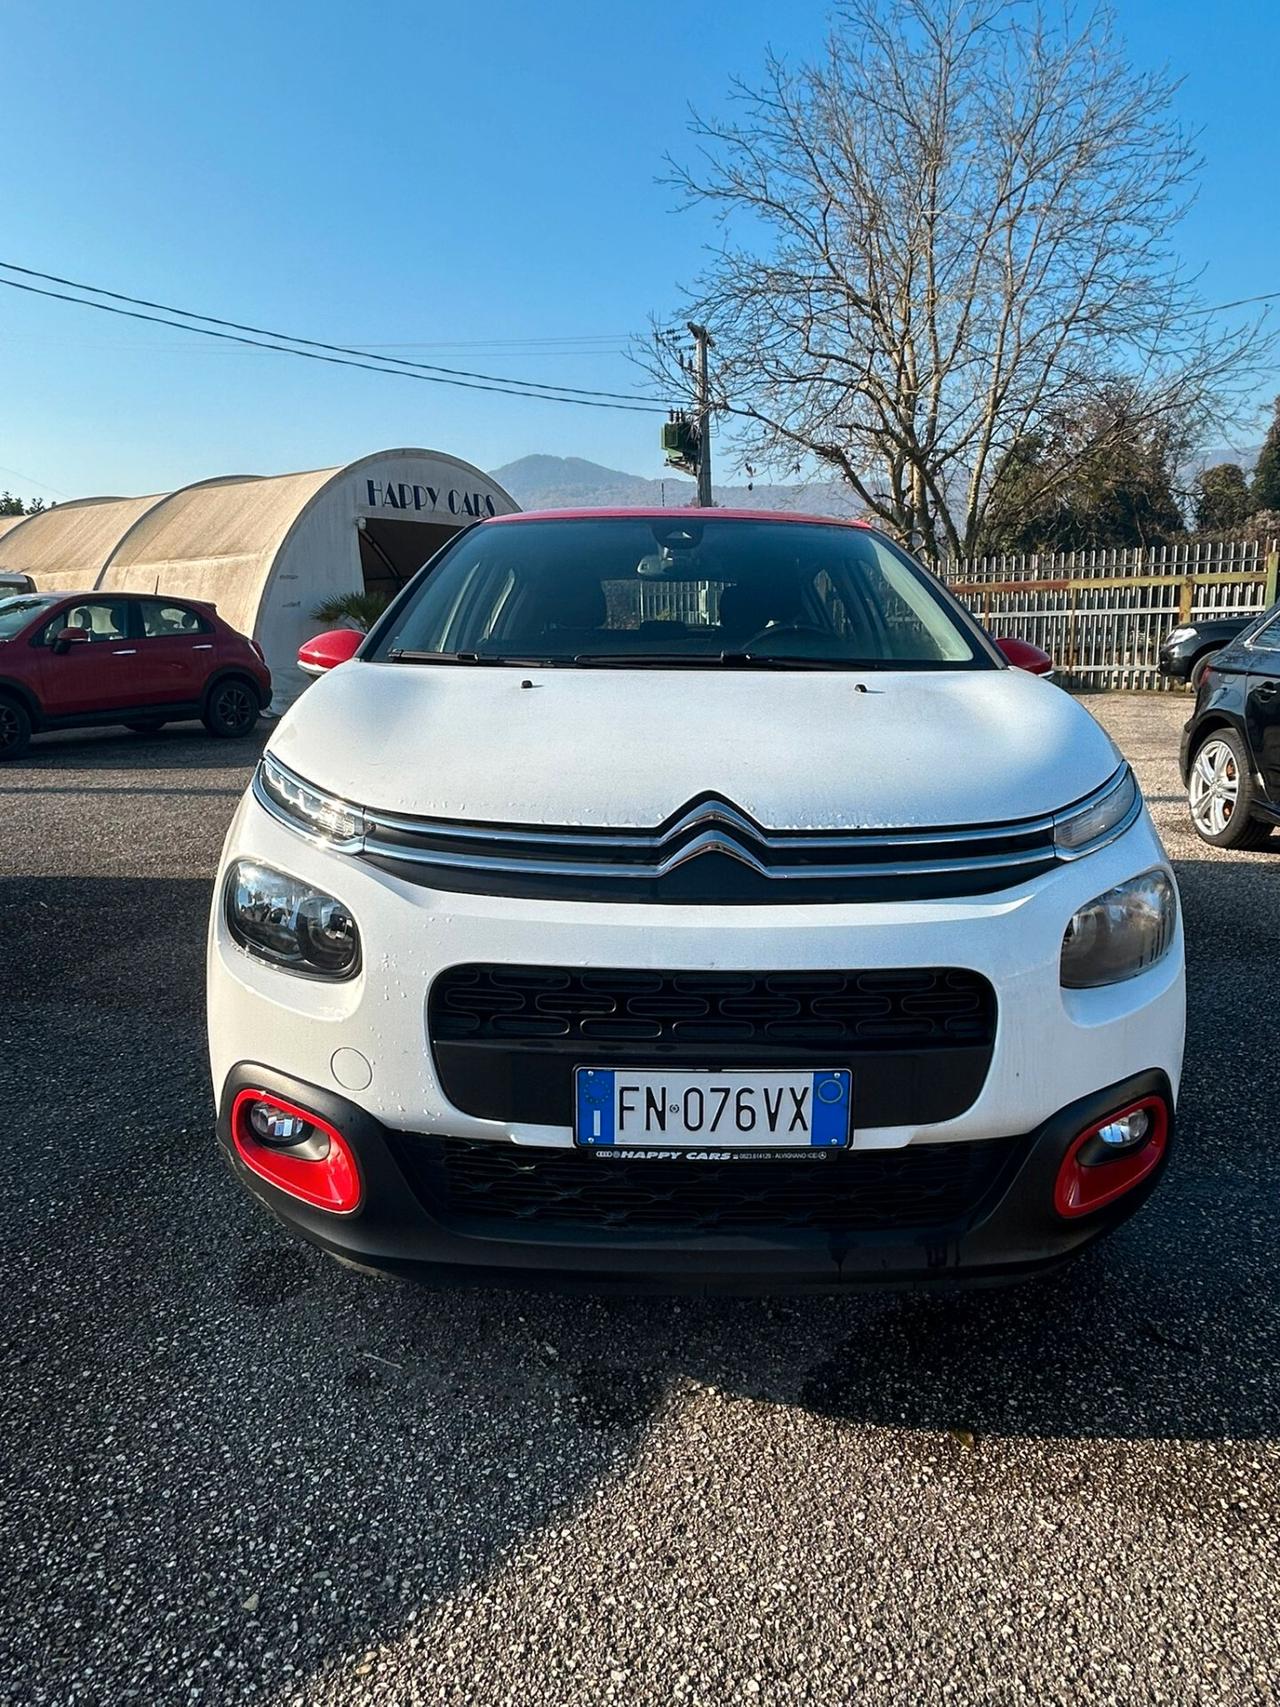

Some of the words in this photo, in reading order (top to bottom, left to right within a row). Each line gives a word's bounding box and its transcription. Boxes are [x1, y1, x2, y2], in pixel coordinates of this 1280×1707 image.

[367, 479, 440, 512] HAPPY
[448, 489, 496, 517] CARS
[621, 1151, 682, 1159] HAPPY
[686, 1152, 731, 1160] CARS
